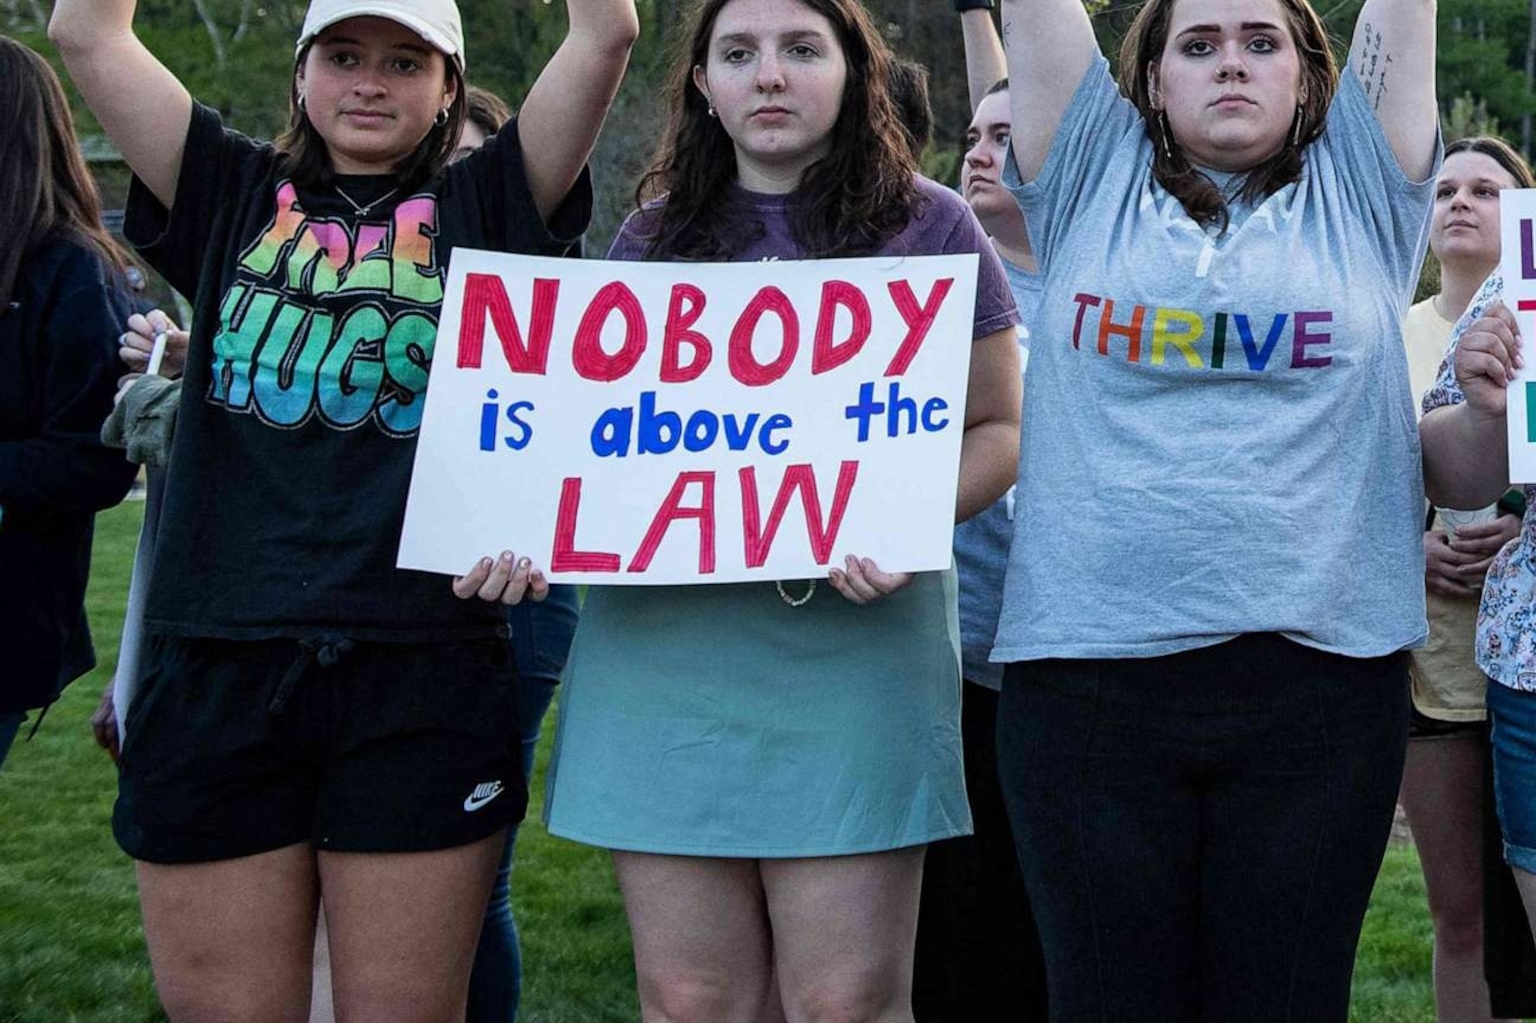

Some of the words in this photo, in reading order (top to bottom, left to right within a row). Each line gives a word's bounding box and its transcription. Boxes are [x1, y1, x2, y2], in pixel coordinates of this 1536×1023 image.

[206, 278, 441, 438] HUGS
[456, 273, 955, 387] NOBODY
[1073, 292, 1333, 372] THRIVE
[479, 388, 535, 451] is
[590, 390, 793, 458] above
[845, 381, 950, 442] the
[550, 460, 859, 574] LAW
[473, 780, 501, 799] NIKE
